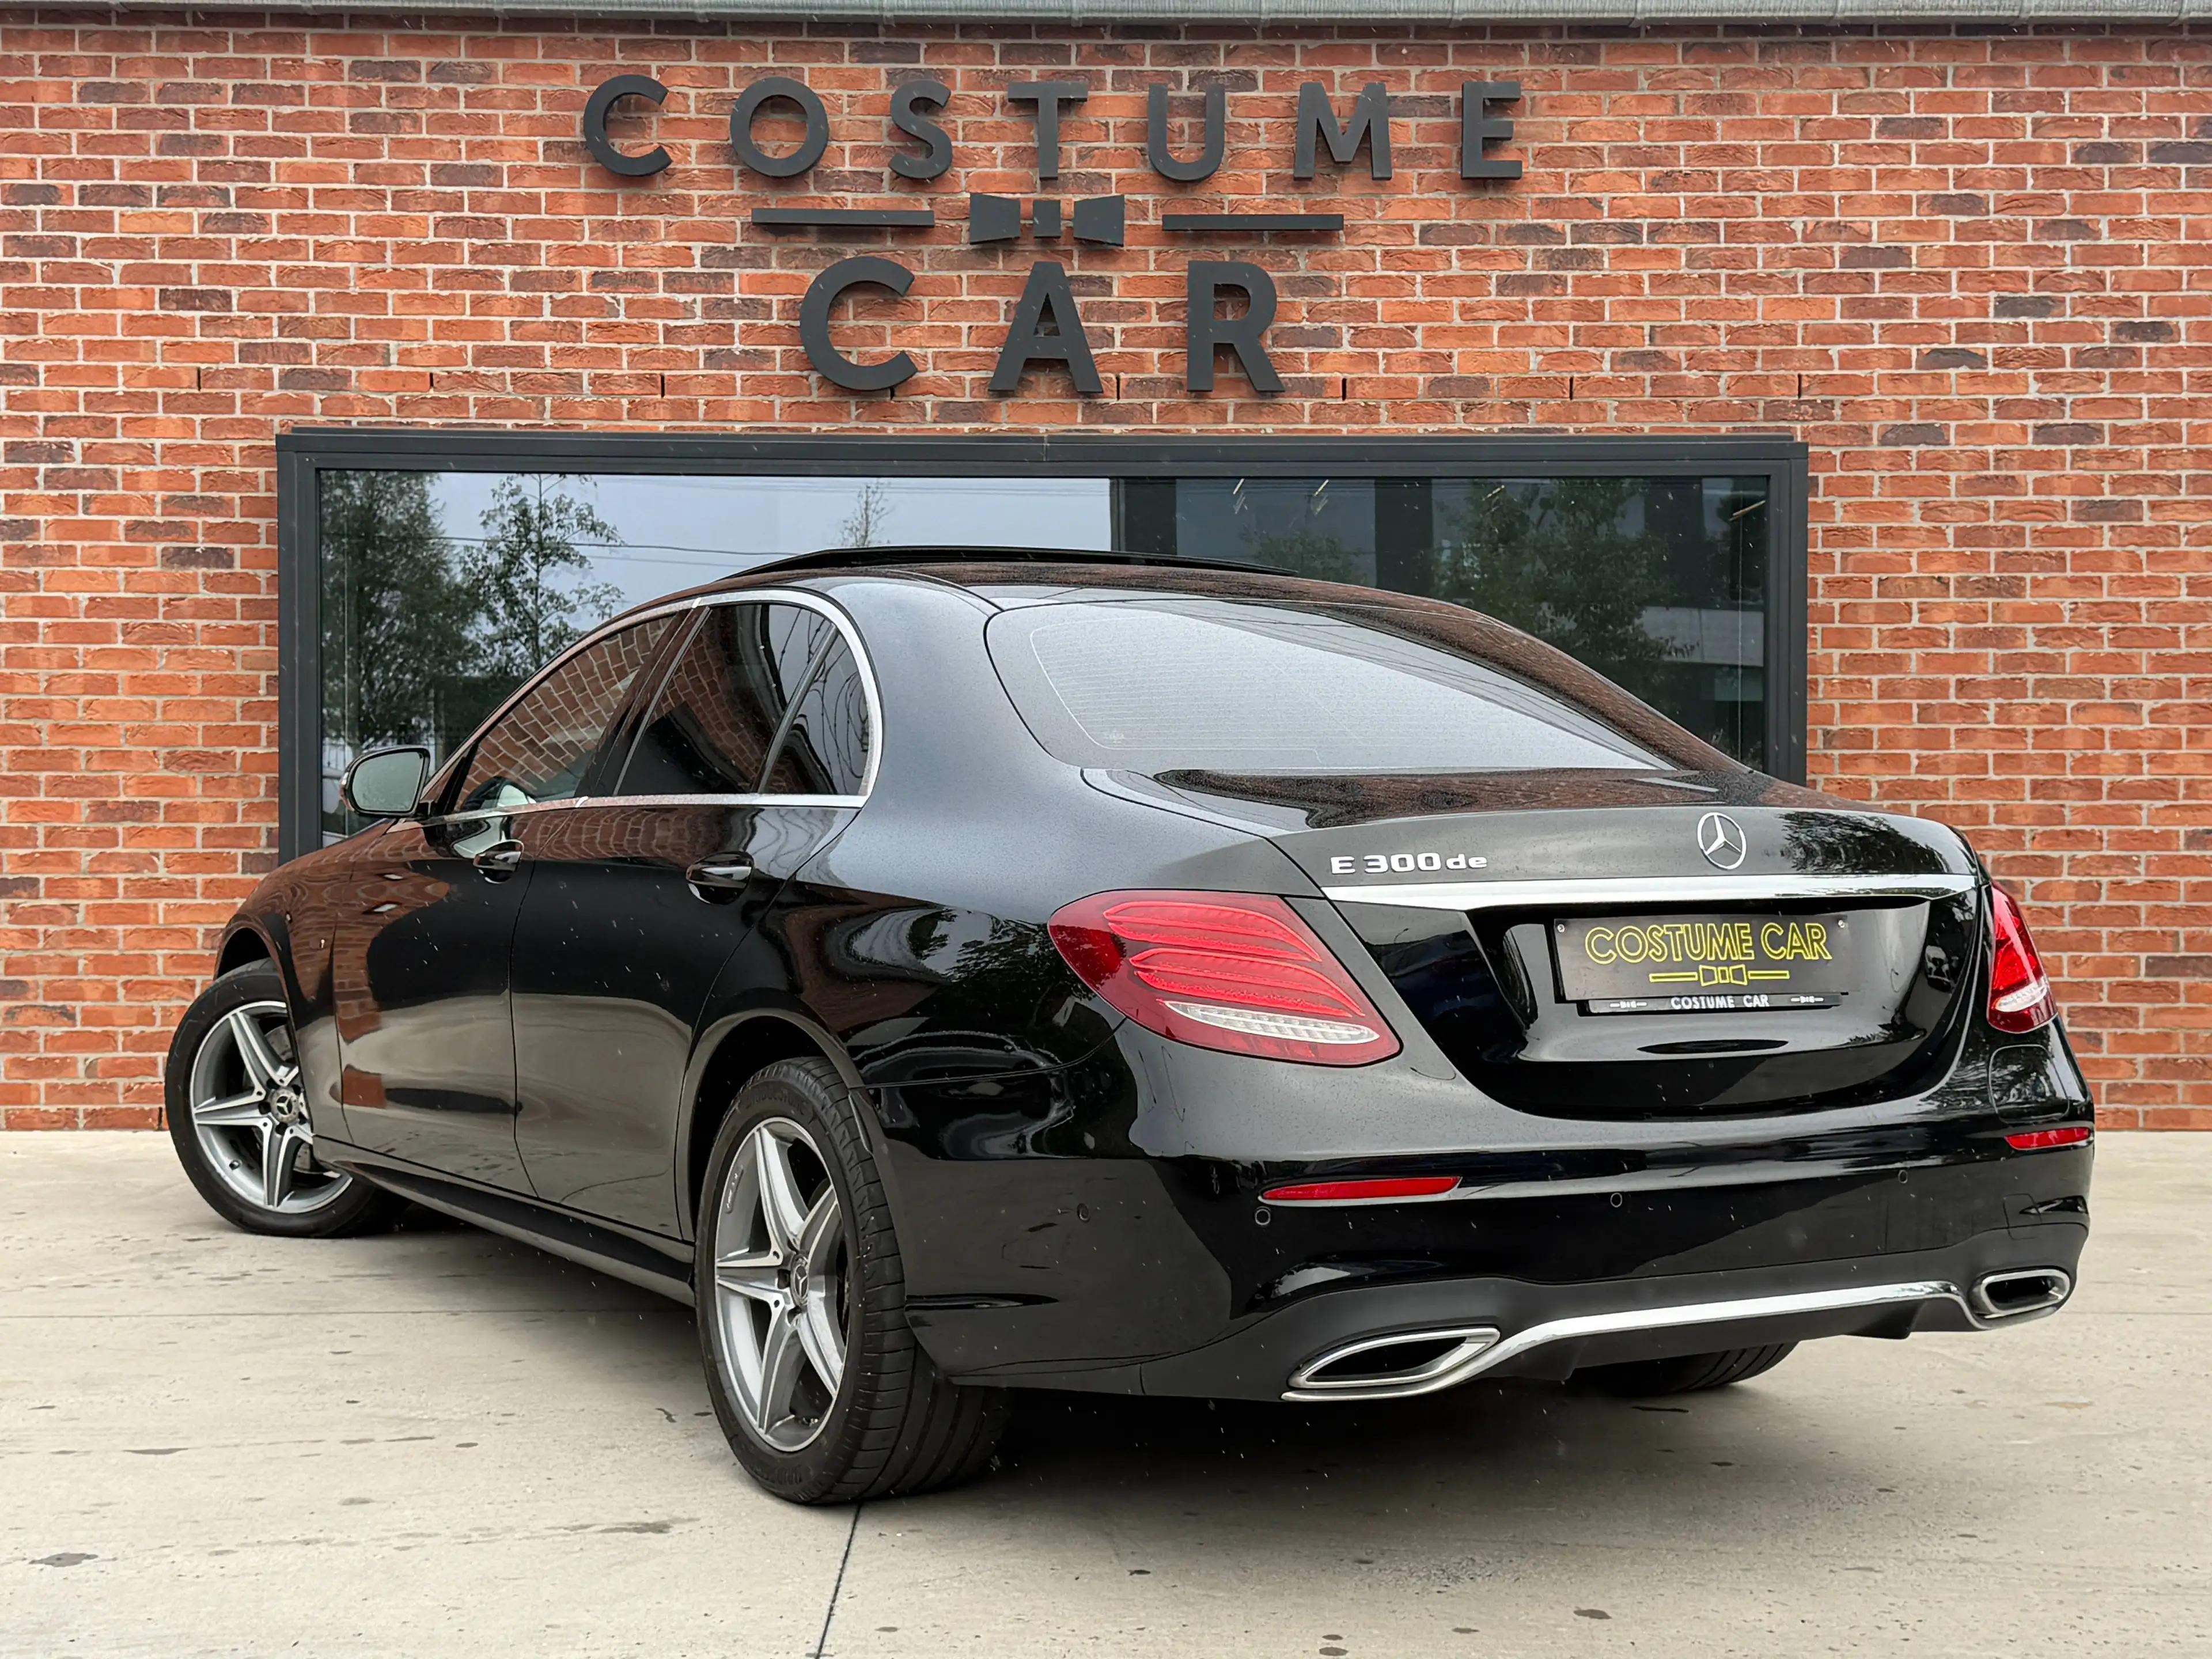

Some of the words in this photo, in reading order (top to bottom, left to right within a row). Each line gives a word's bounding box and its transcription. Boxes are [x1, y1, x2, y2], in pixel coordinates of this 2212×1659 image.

[583, 73, 1523, 181] COSTUME
[800, 255, 1285, 394] CAR
[1330, 856, 1355, 874] E
[1584, 922, 1755, 965] COSTUME
[1760, 922, 1832, 960] CAR
[1671, 995, 1735, 1010] COSTUME
[1743, 994, 1770, 1008] CAR
